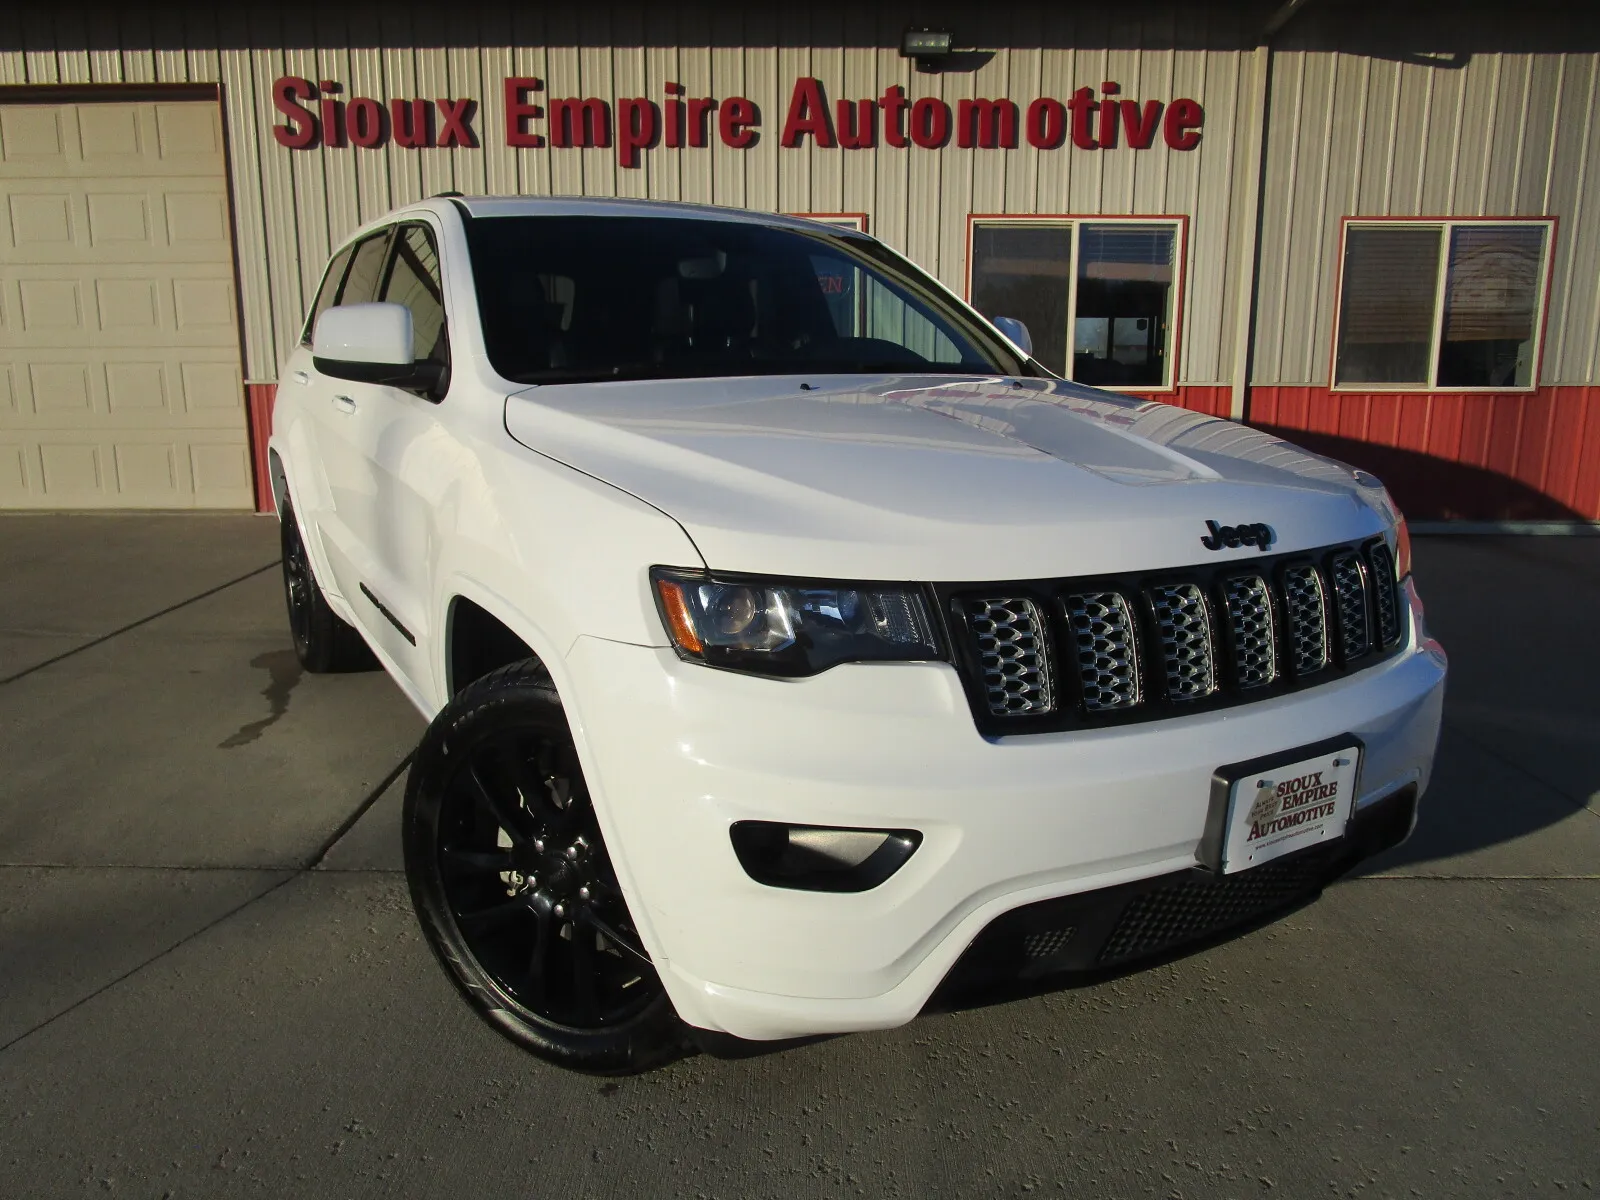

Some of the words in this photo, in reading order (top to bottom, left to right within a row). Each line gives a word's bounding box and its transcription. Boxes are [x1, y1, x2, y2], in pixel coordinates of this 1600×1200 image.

[272, 76, 477, 149] Sioux
[504, 76, 757, 168] Empire
[781, 76, 1203, 151] Automotive
[1200, 519, 1272, 552] Jeep
[1276, 771, 1323, 798] SIOUX
[1281, 781, 1338, 811] EMPIRE
[1247, 802, 1335, 841] AUTOMOTIVE
